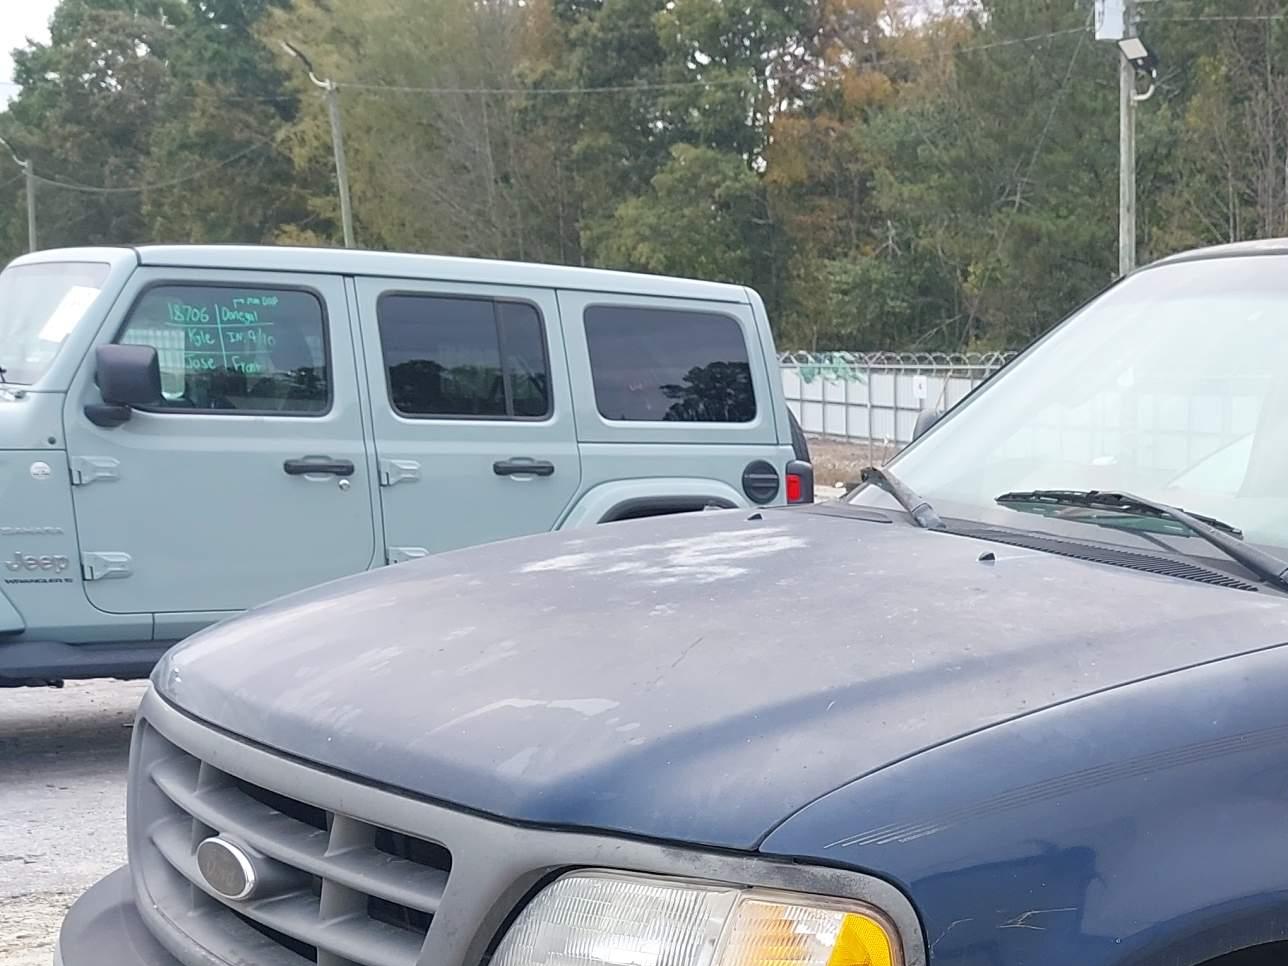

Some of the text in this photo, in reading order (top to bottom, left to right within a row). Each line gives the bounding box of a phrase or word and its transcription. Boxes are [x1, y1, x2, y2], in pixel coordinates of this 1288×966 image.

[167, 303, 209, 322] 18706
[188, 328, 216, 346] Kyle
[186, 354, 216, 369] Jose
[5, 551, 69, 574] Jeep
